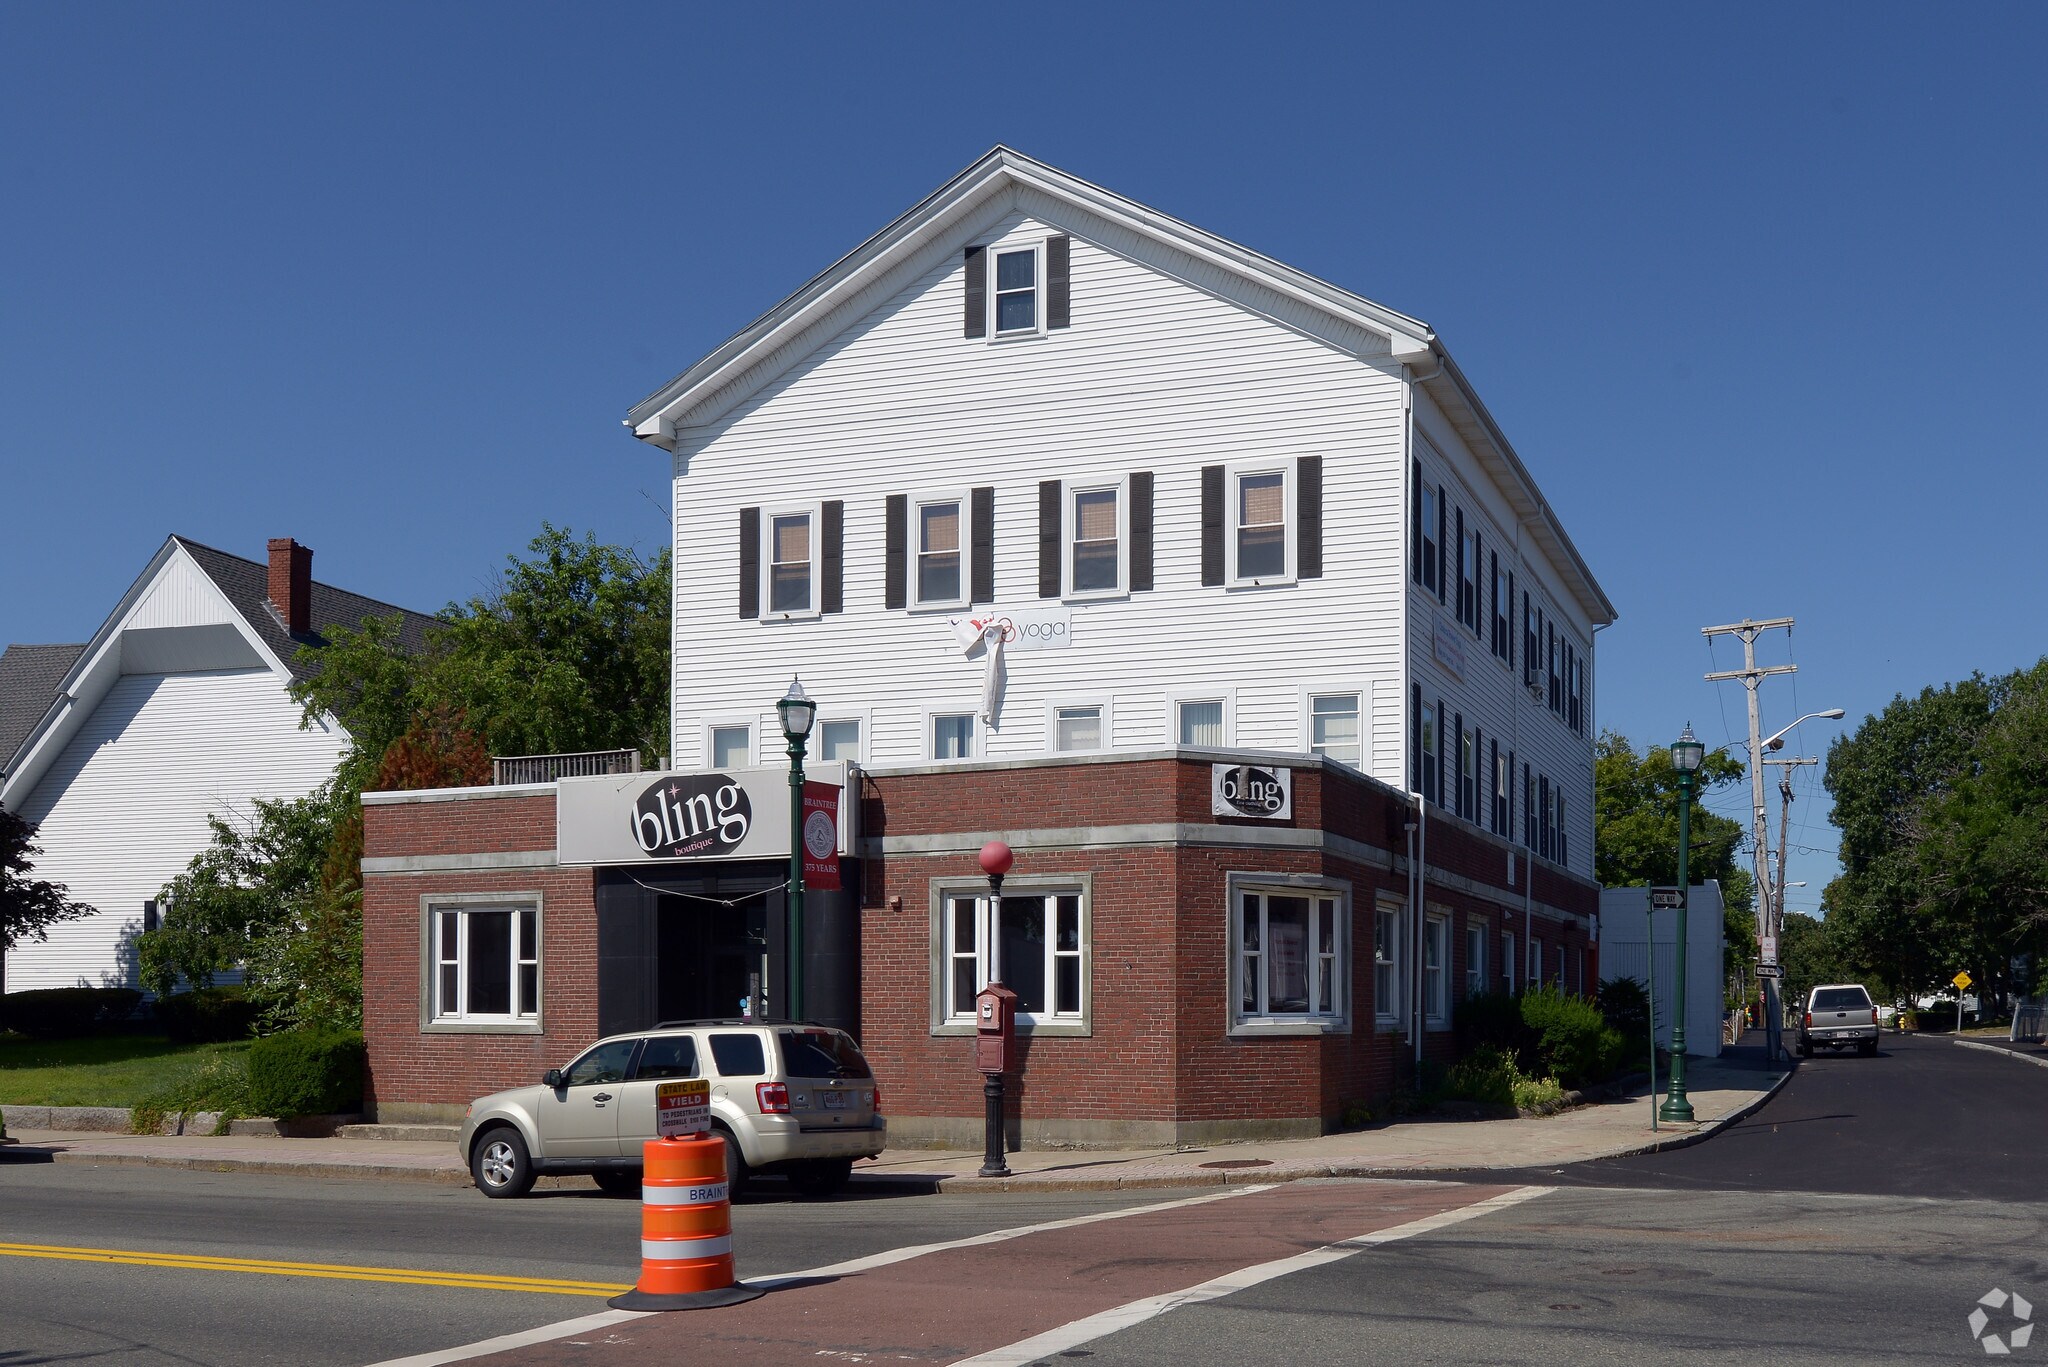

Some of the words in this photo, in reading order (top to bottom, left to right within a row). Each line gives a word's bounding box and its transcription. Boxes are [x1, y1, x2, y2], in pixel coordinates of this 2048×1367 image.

[1018, 621, 1066, 641] yoga
[804, 797, 837, 810] BRAINTREE
[633, 782, 748, 852] bling
[674, 837, 714, 856] boutique
[805, 863, 816, 872] 375
[816, 863, 837, 873] YEARS
[1655, 894, 1665, 903] ONE
[1666, 895, 1676, 903] WAY
[663, 1084, 688, 1095] STATE
[690, 1081, 708, 1092] LAW
[669, 1095, 702, 1107] YIELD
[662, 1112, 670, 1120] TO
[670, 1108, 702, 1118] PEDESTRIANS
[662, 1118, 687, 1127] CROSSWALK
[700, 1115, 709, 1123] FINE
